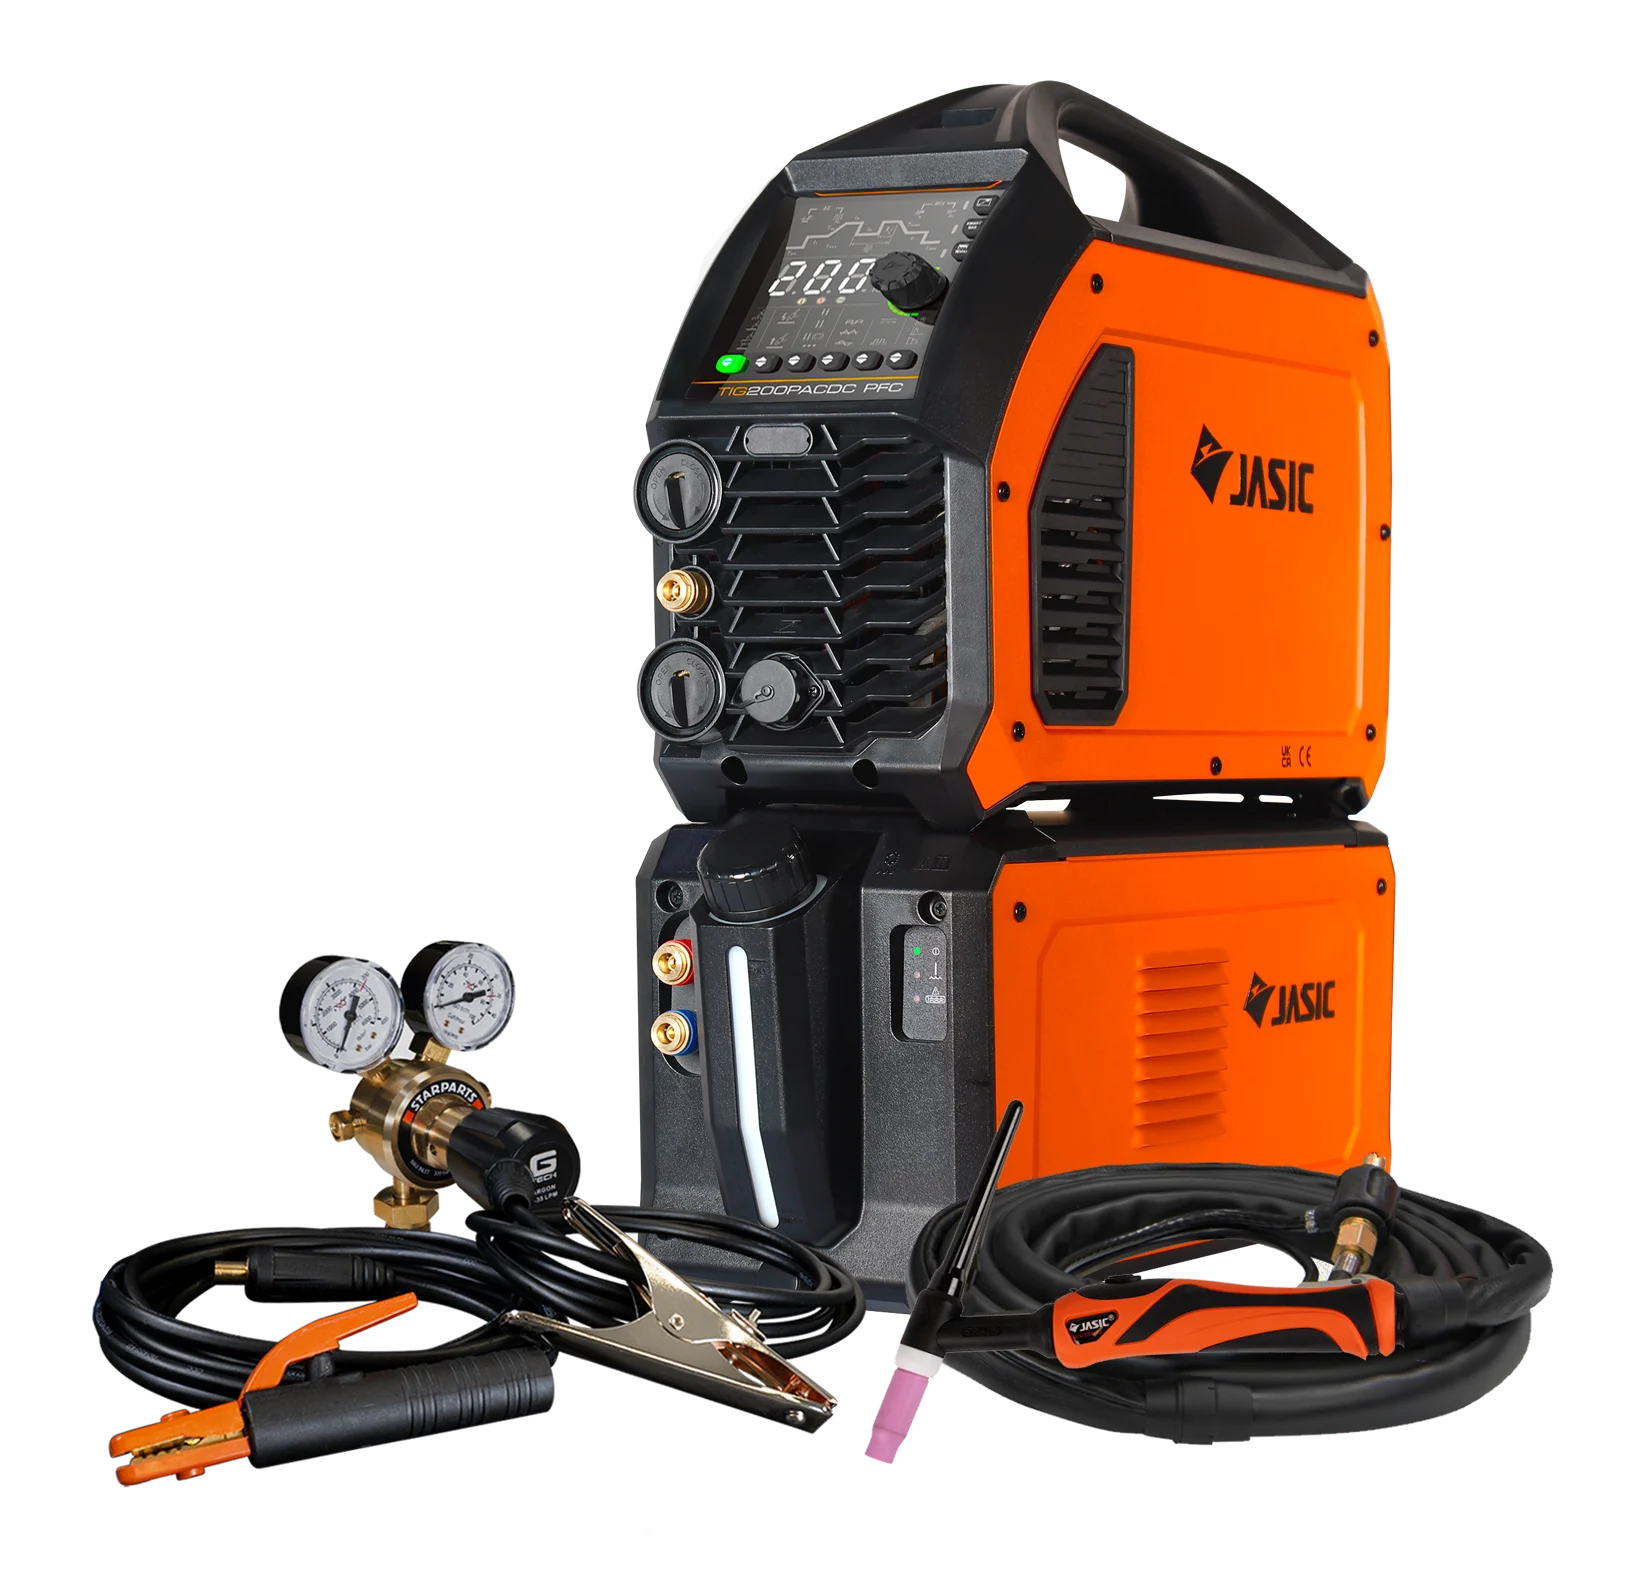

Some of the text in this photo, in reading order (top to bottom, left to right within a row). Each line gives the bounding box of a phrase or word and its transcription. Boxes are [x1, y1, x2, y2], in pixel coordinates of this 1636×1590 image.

[718, 382, 904, 397] TIG200PACDC PFC
[651, 466, 665, 490] OPEN
[1229, 452, 1315, 515] JASIC
[656, 663, 671, 686] OPEN
[1271, 980, 1336, 1026] JASIC
[410, 1081, 478, 1112] STARPARTS
